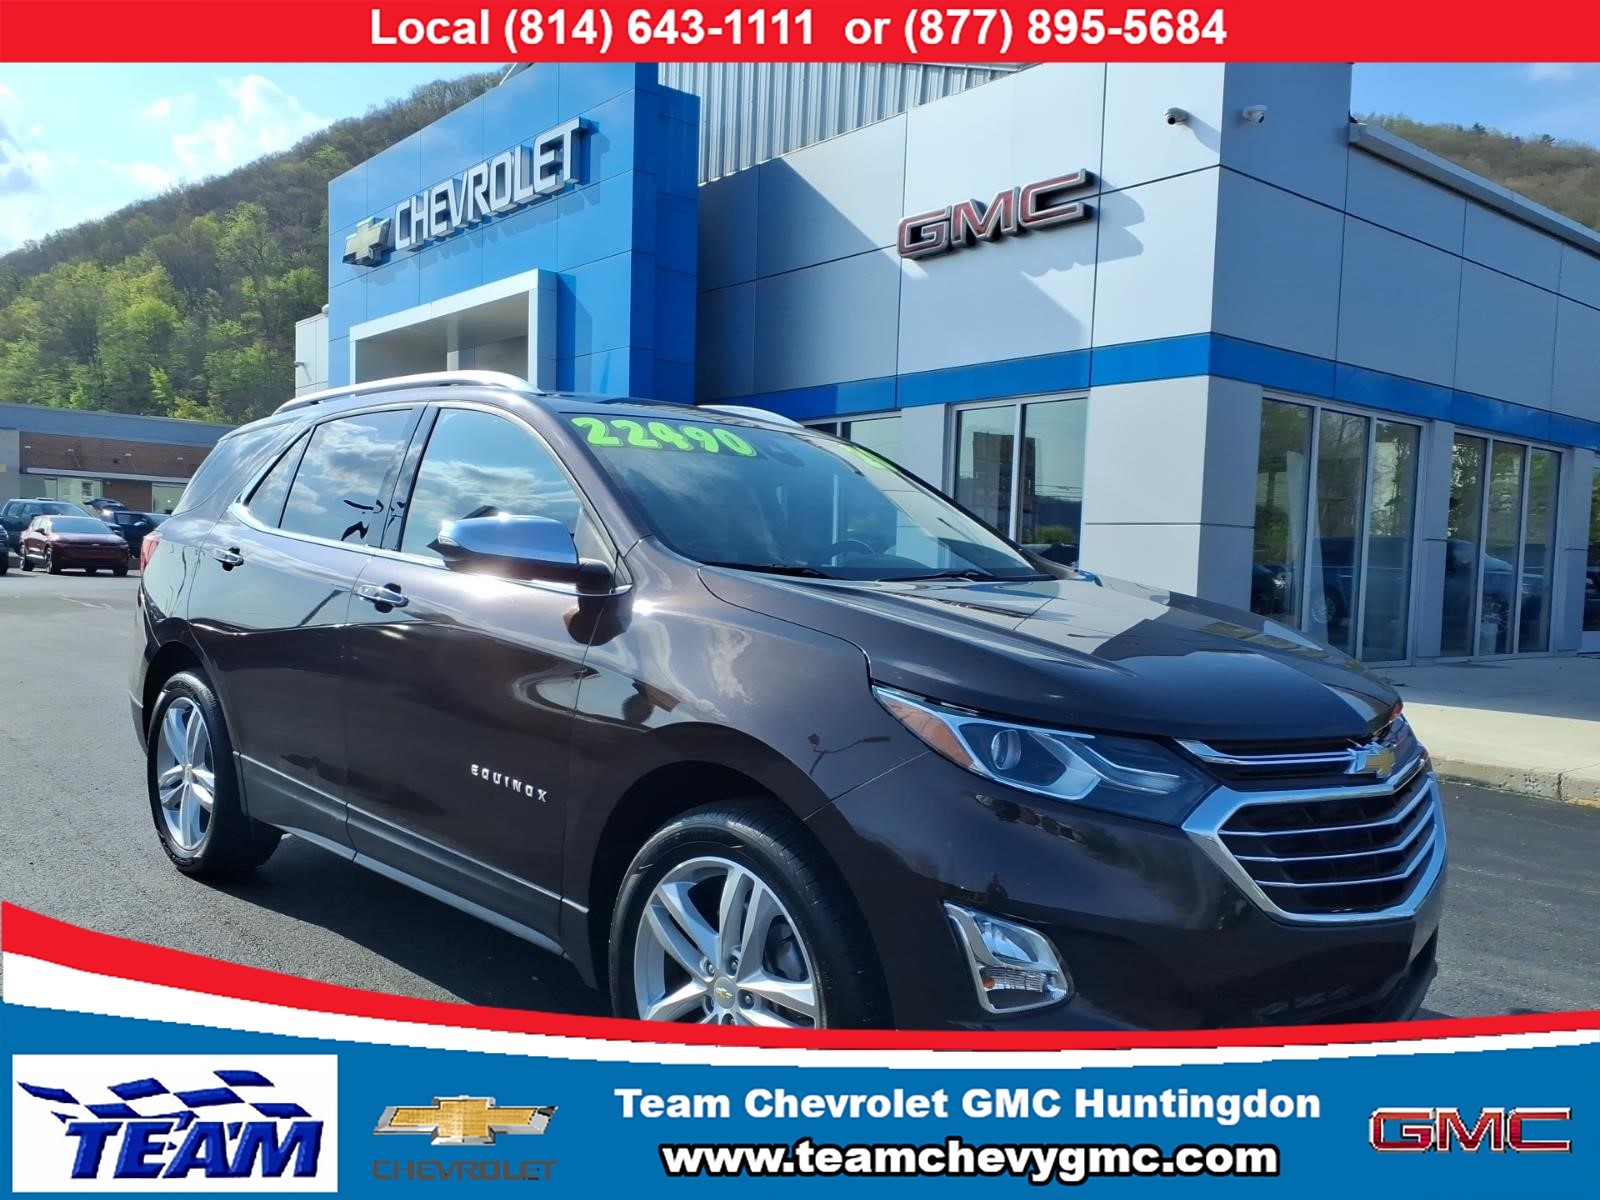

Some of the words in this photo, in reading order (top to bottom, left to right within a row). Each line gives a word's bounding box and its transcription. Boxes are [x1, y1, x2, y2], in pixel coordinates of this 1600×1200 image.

[393, 116, 588, 252] CHEVROLET
[896, 168, 1092, 259] GMC
[571, 416, 757, 458] 22490
[470, 763, 548, 803] EQUINOX
